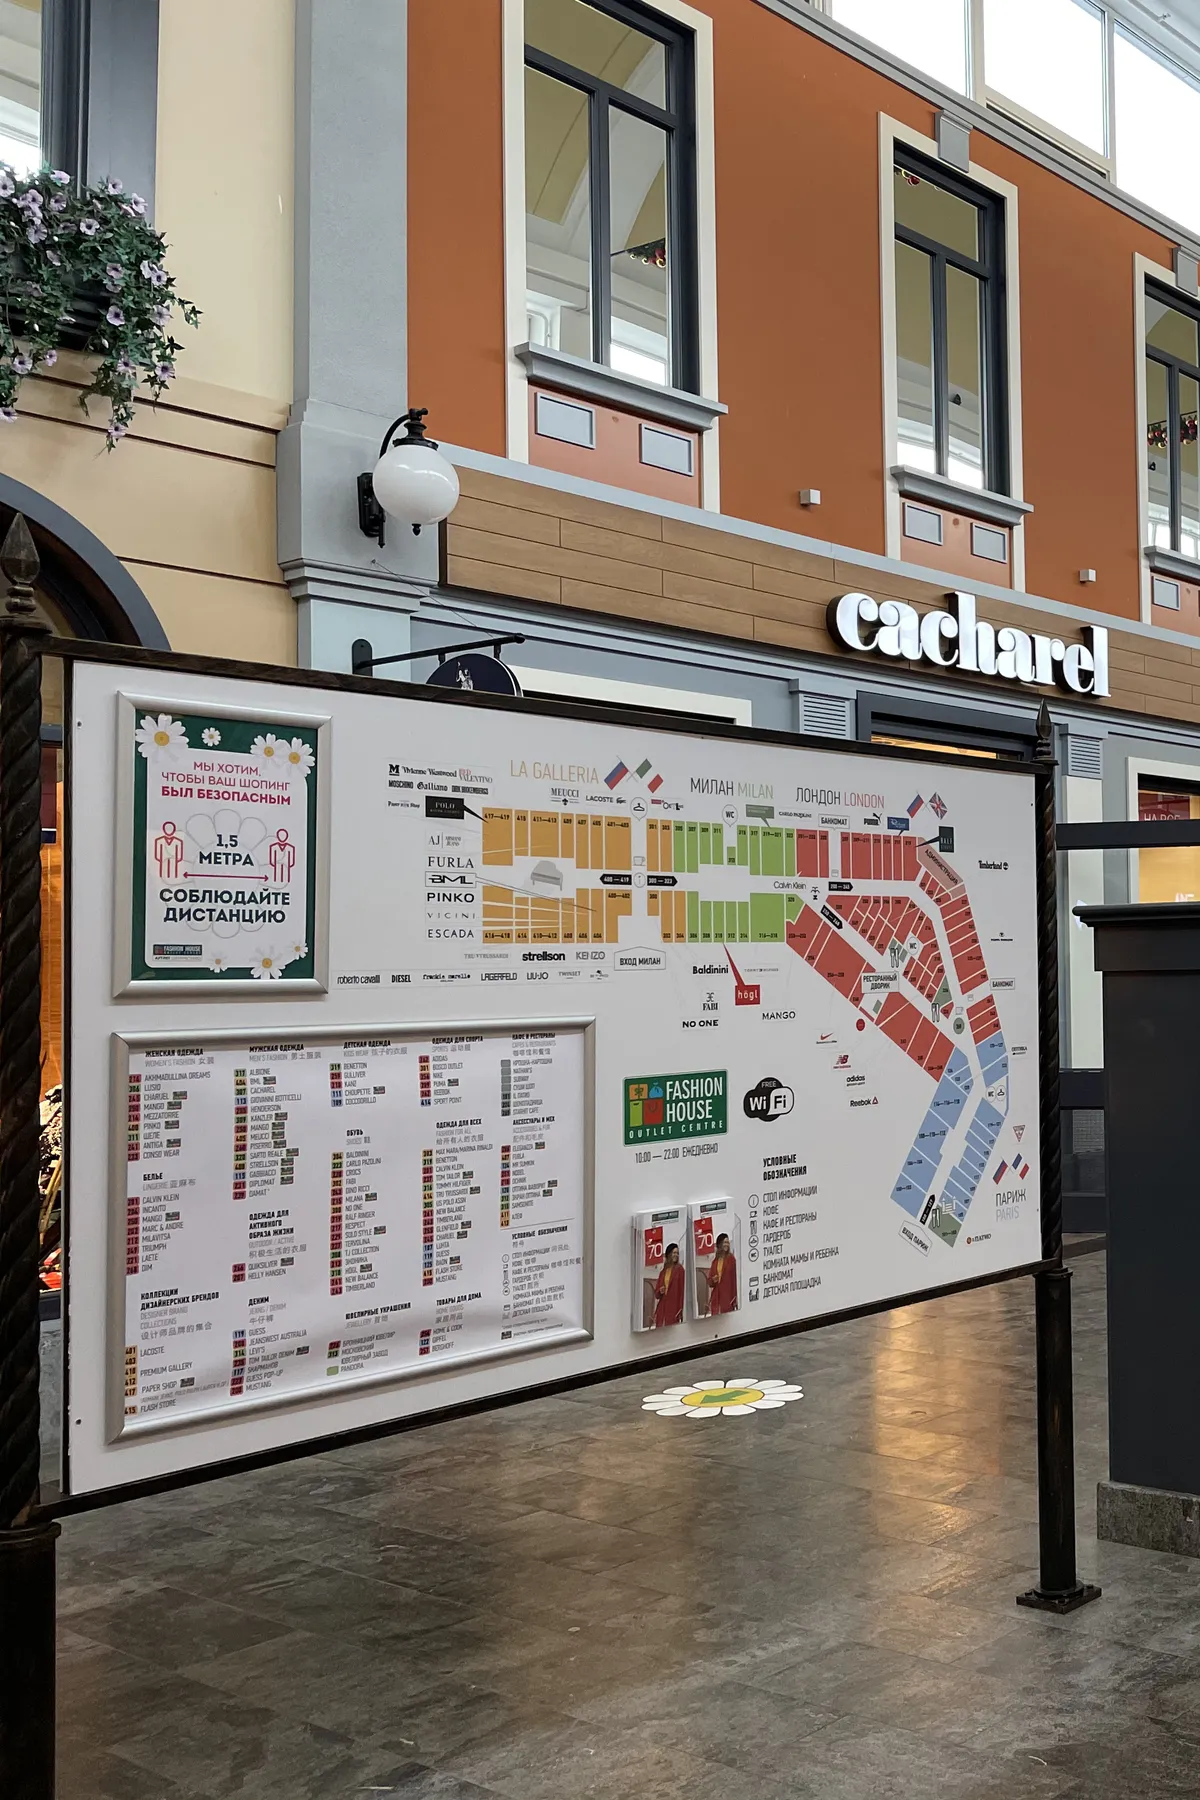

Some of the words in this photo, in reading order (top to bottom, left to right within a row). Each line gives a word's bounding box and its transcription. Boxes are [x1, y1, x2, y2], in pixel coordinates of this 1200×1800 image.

[831, 591, 1111, 697] cacharel
[194, 761, 214, 772] МЫ
[217, 763, 261, 776] ХОТИМ,
[510, 760, 528, 778] LA
[533, 762, 599, 784] GALLERIA
[161, 772, 205, 784] ЧТОБЫ
[208, 775, 236, 787] ВАШ
[239, 778, 290, 792] ШОПИНГ
[416, 782, 448, 792] Galliano
[551, 788, 580, 798] MEUCCI
[690, 778, 734, 796] МИЛАН
[738, 782, 773, 799] MILAN
[161, 786, 193, 798] БЫЛ
[197, 788, 291, 806] БЕЗОПАСНЫМ
[796, 788, 840, 806] ЛОНДОН
[844, 792, 884, 808] LONDON
[726, 810, 734, 819] WC
[820, 817, 848, 826] БАНКОМАТ
[216, 834, 238, 850] 1,5
[199, 852, 254, 866] МЕТРА
[428, 856, 474, 868] FURLA
[428, 874, 473, 884] BML
[774, 881, 792, 889] Calvin
[159, 888, 290, 906] СОБЛЮДАЙТЕ
[427, 892, 474, 903] PINKO
[164, 908, 286, 924] ДИСТАНЦИЮ
[428, 929, 474, 938] ESCADA
[522, 951, 566, 962] strellson
[576, 952, 606, 960] KENZO
[620, 958, 636, 967] ВХОД
[638, 958, 661, 966] МИЛАН
[692, 964, 728, 974] Baldinini
[337, 976, 360, 984] roberto
[360, 974, 380, 984] cavalli
[392, 974, 412, 983] DIESEL
[481, 972, 518, 982] LAGERFELD
[863, 974, 897, 982] РЕСТОРАННЫЙ
[870, 982, 890, 990] ДВОРИК
[702, 1002, 718, 1010] FABI
[762, 1011, 796, 1020] MANGO
[682, 1020, 696, 1028] NO
[176, 1048, 204, 1056] ОДЕЖДА
[666, 1077, 722, 1100] FASHION
[750, 1096, 766, 1111] Wi
[774, 1095, 786, 1110] Fi
[850, 1098, 872, 1107] Reebok
[666, 1100, 712, 1122] HOUSE
[630, 1126, 672, 1138] OUTLET
[682, 1120, 722, 1132] CENTRE
[635, 1152, 652, 1164] 10:00
[664, 1148, 680, 1160] 22:00
[682, 1142, 718, 1158] ЕЖЕДНЕВНО
[762, 1154, 797, 1168] УСЛОВНЫЕ
[143, 1172, 163, 1181] БЕЛЬЕ
[763, 1166, 807, 1181] ОБОЗНАЧЕНИЯ
[142, 1196, 162, 1204] CALVIN
[164, 1194, 180, 1202] KLEIN
[762, 1192, 778, 1202] СТОЛ
[778, 1186, 818, 1200] ИНФОРМАЦИИ
[996, 1188, 1026, 1207] ПАРИЖ
[250, 1212, 275, 1221] ОДЕЖДА
[276, 1210, 289, 1218] ДЛЯ
[762, 1205, 779, 1216] КОФЕ
[996, 1206, 1020, 1222] PARIS
[249, 1220, 282, 1230] АКТИВНОГО
[762, 1218, 779, 1230] КАФЕ
[780, 1218, 784, 1226] И
[785, 1212, 817, 1226] РЕСТОРАНЫ
[249, 1230, 272, 1240] ОБРАЗА
[273, 1228, 294, 1236] ЖИЗНИ
[763, 1230, 792, 1244] ГАРДЕРОБ
[902, 1226, 913, 1242] ВХОД
[913, 1235, 929, 1252] ПАРИЖ
[763, 1244, 783, 1256] ТУАЛЕТ
[763, 1256, 790, 1270] КОМНАТА
[790, 1252, 809, 1265] МАМЫ
[810, 1252, 815, 1260] И
[815, 1246, 840, 1260] РЕБЕНКА
[763, 1268, 794, 1284] БАНКОМАТ
[762, 1284, 789, 1299] ДЕТСКАЯ
[790, 1276, 822, 1292] ПЛОЩАДКА
[140, 1288, 178, 1300] КОЛЛЕКЦИИ
[140, 1296, 190, 1311] ДИЗАЙНЕРСКИХ
[192, 1292, 220, 1303] БРЕНДОВ
[248, 1296, 270, 1306] ДЕНИМ
[140, 1346, 164, 1357] LACOSTE
[140, 1366, 167, 1376] PREMIUM
[168, 1362, 193, 1372] GALLERY
